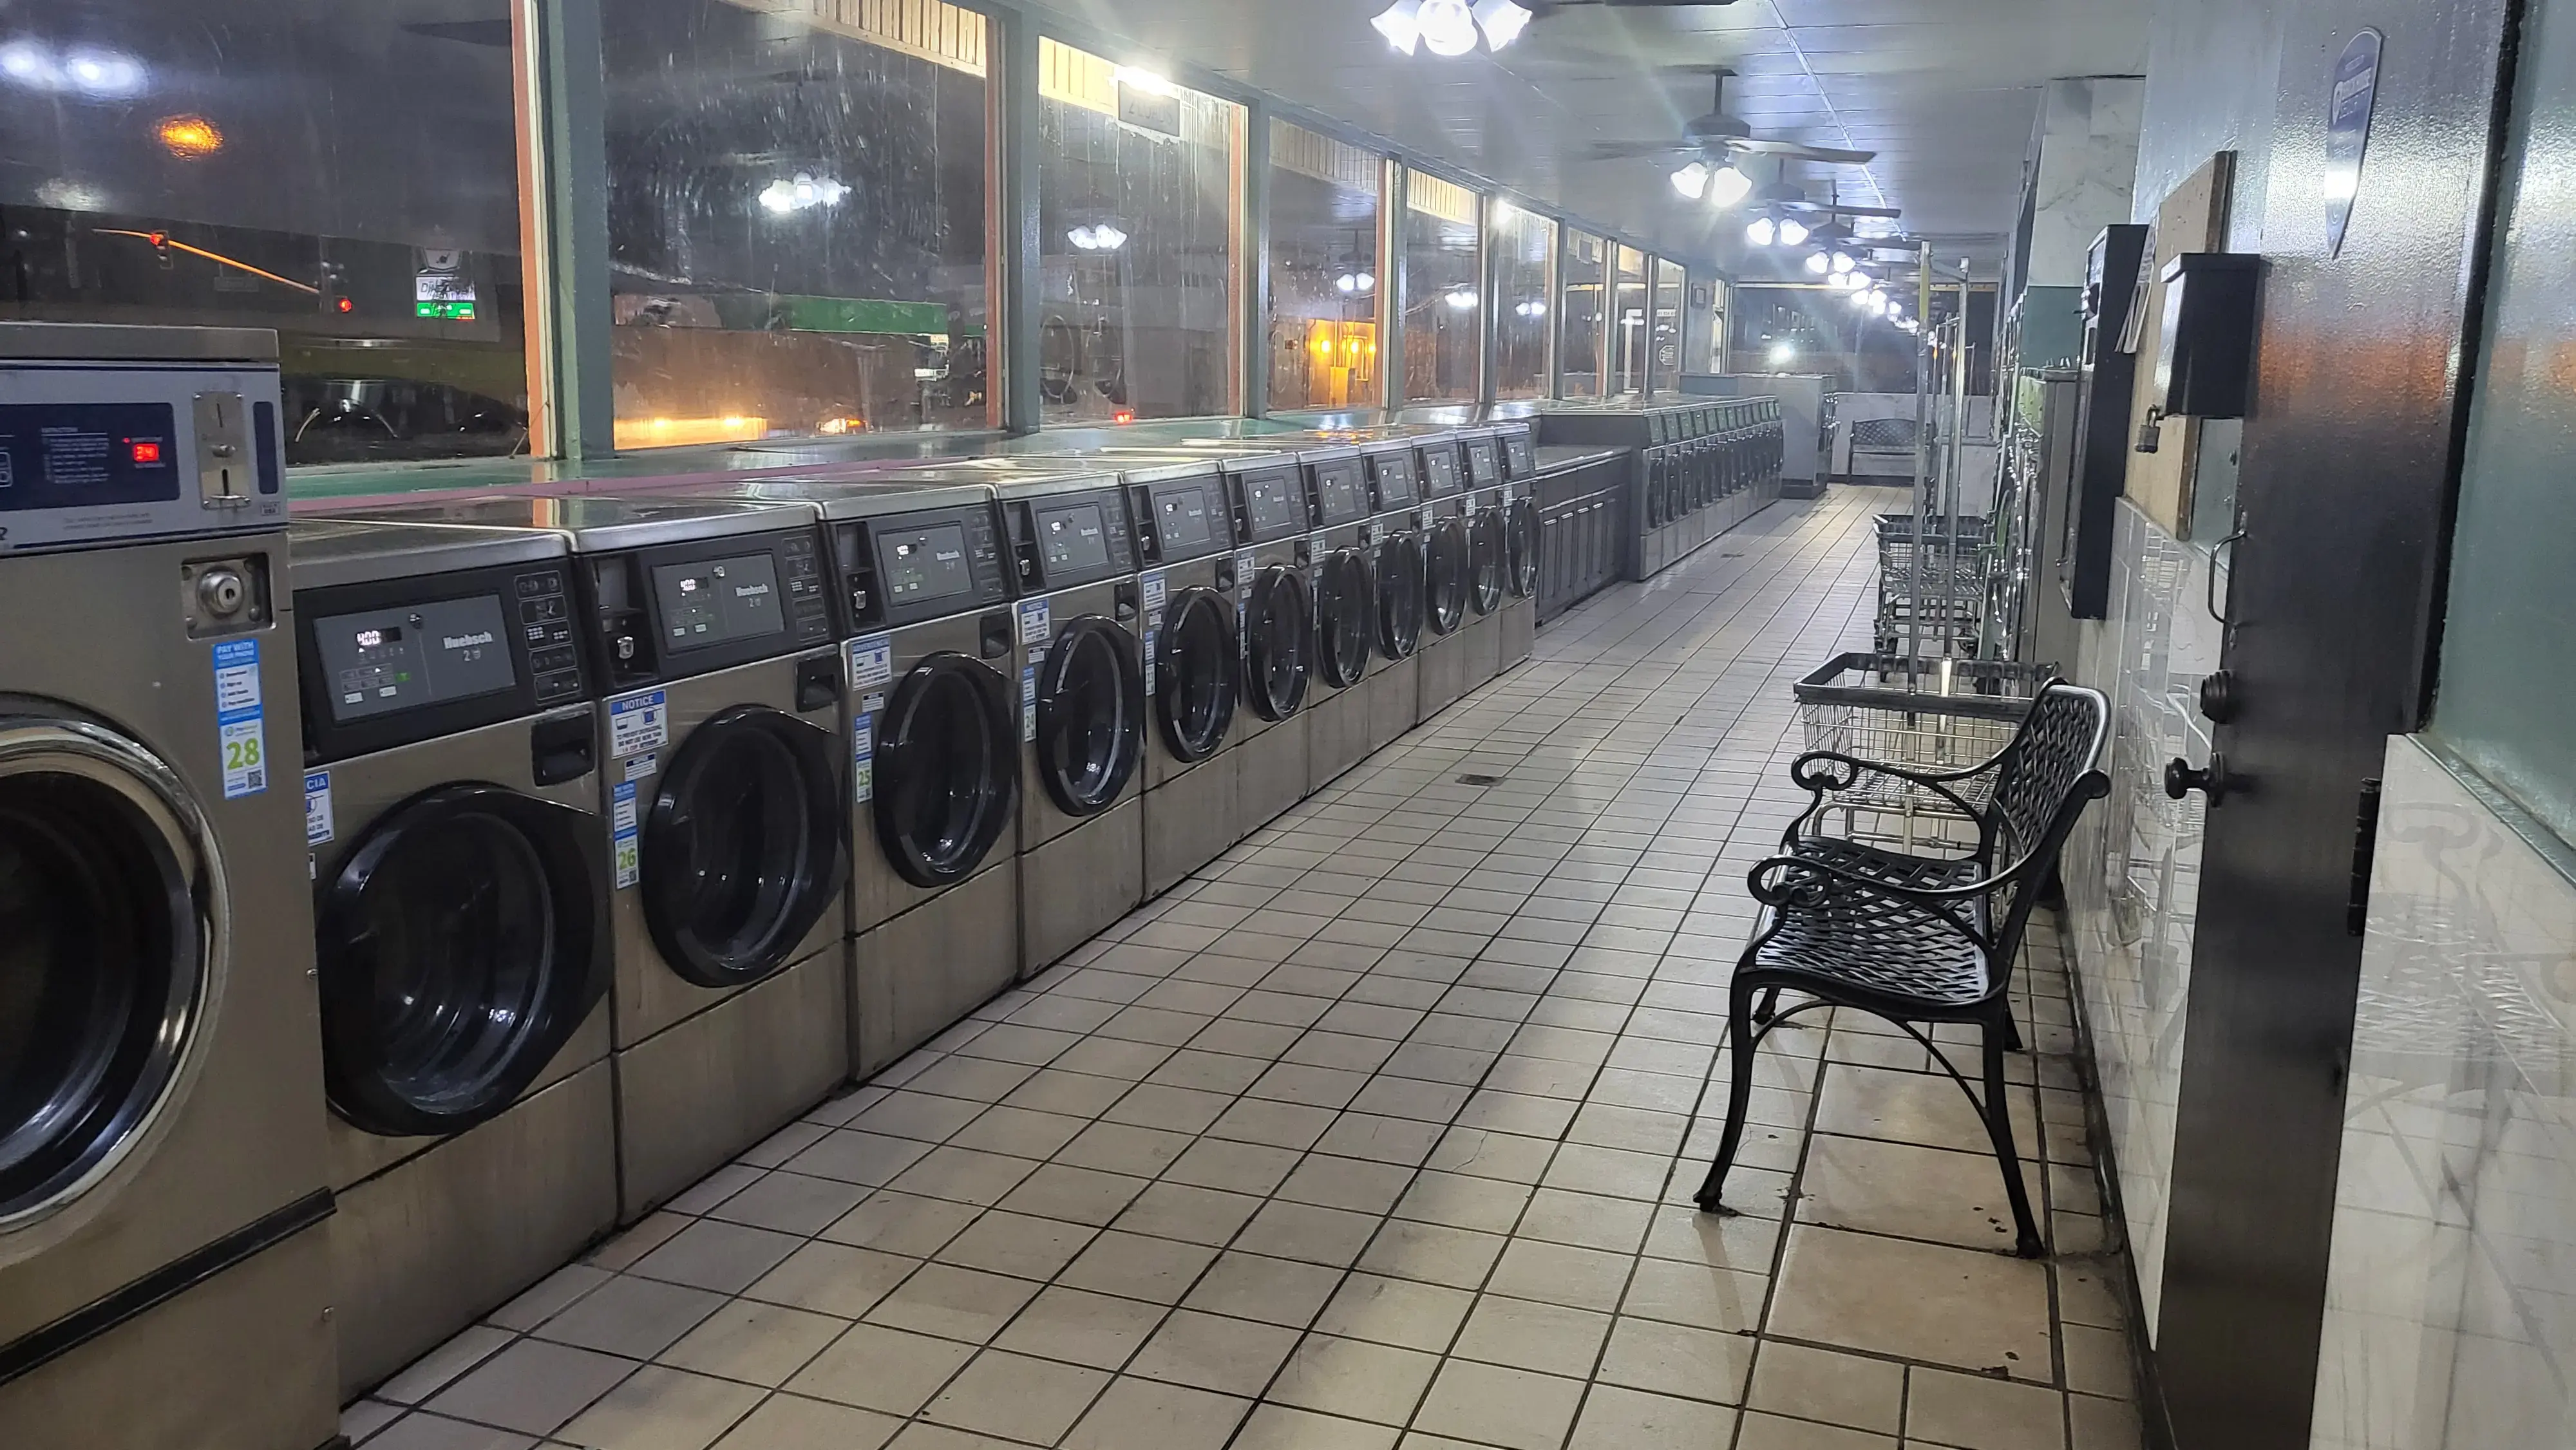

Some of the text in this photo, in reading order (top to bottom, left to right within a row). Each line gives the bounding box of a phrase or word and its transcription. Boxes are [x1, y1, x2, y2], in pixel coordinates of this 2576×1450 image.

[442, 631, 493, 649] Huebsch
[621, 695, 655, 711] NOTICE
[226, 738, 260, 771] 28
[305, 777, 327, 790] CIA
[858, 769, 871, 787] 25
[618, 847, 637, 870] 26
